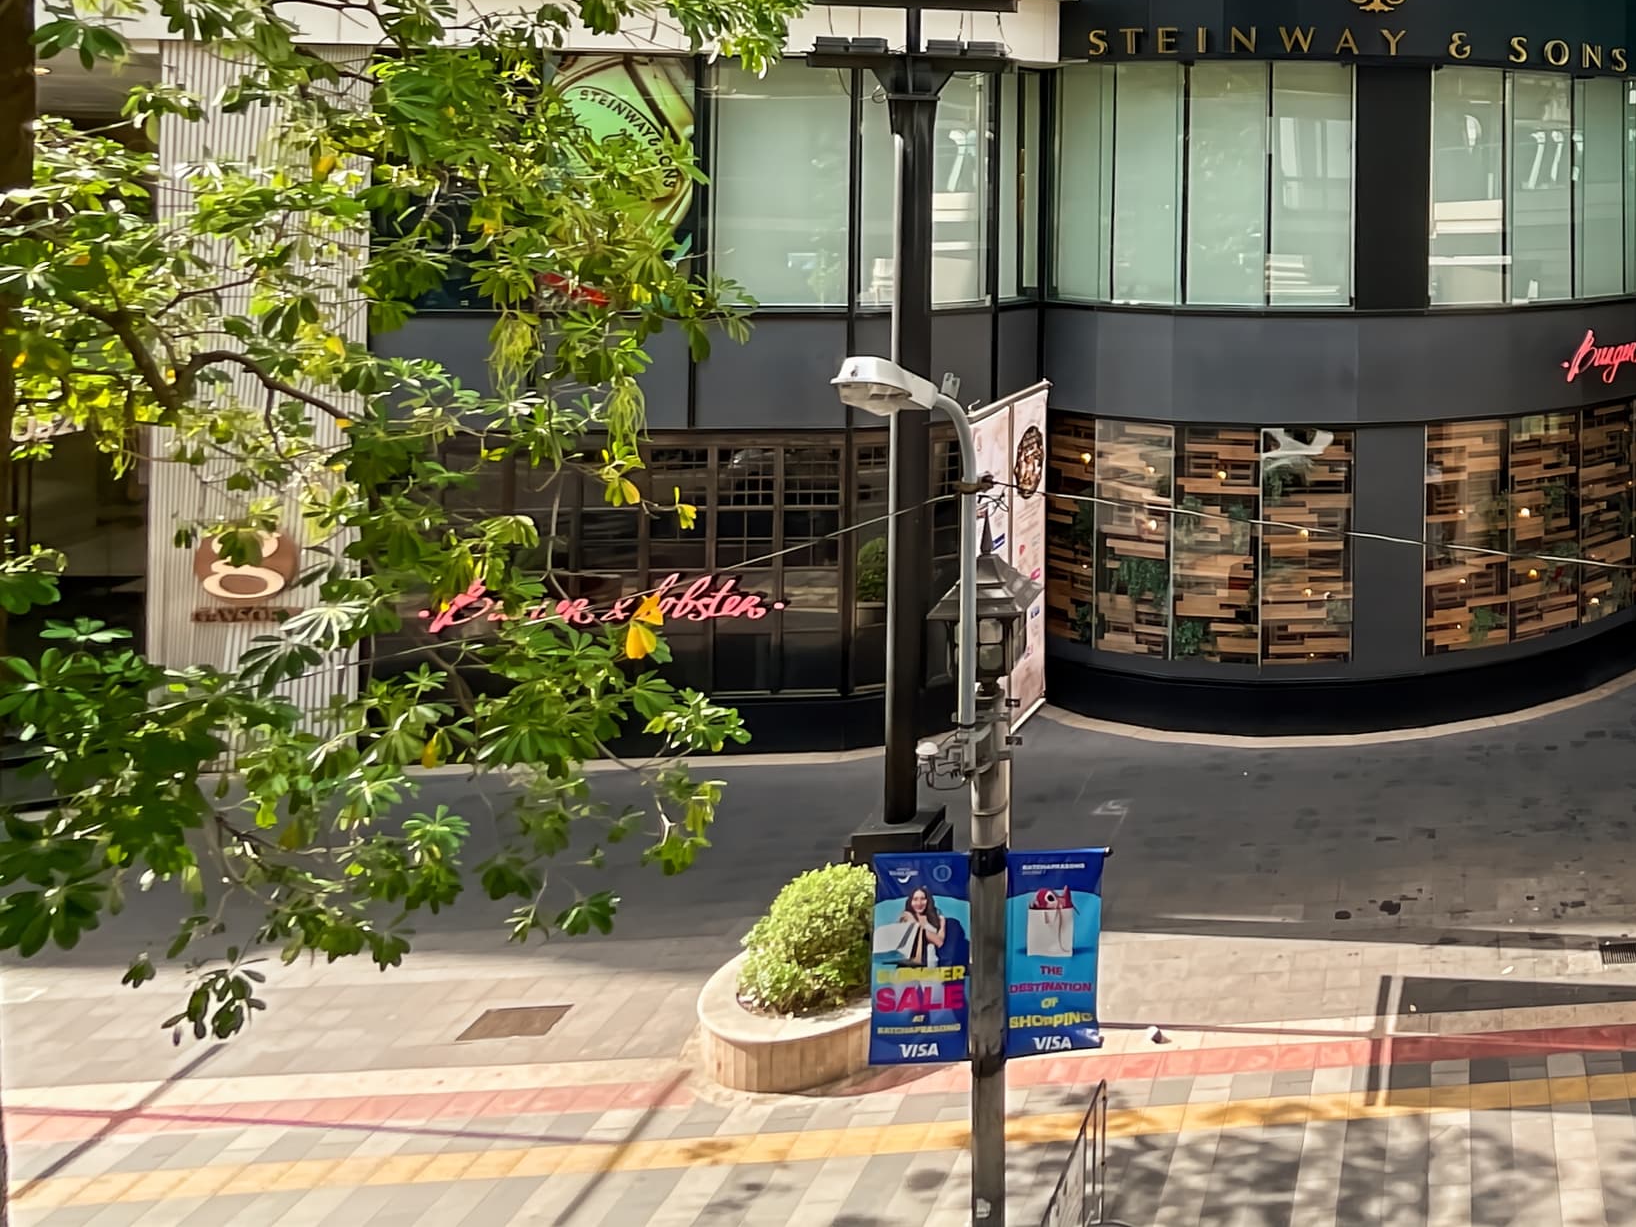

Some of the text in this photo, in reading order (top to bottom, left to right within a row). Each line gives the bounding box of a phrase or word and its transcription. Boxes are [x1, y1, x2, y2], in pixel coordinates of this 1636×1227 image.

[1087, 25, 1628, 73] STEINWAY & SONS
[579, 89, 657, 137] STEINWAY
[1039, 965, 1063, 976] THE
[1008, 981, 1092, 994] DESTINATION
[875, 984, 965, 1013] SALE
[1040, 996, 1060, 1009] OF
[1009, 1013, 1093, 1029] SHOPPING
[899, 1042, 940, 1058] VISA
[1032, 1035, 1073, 1051] VISA
